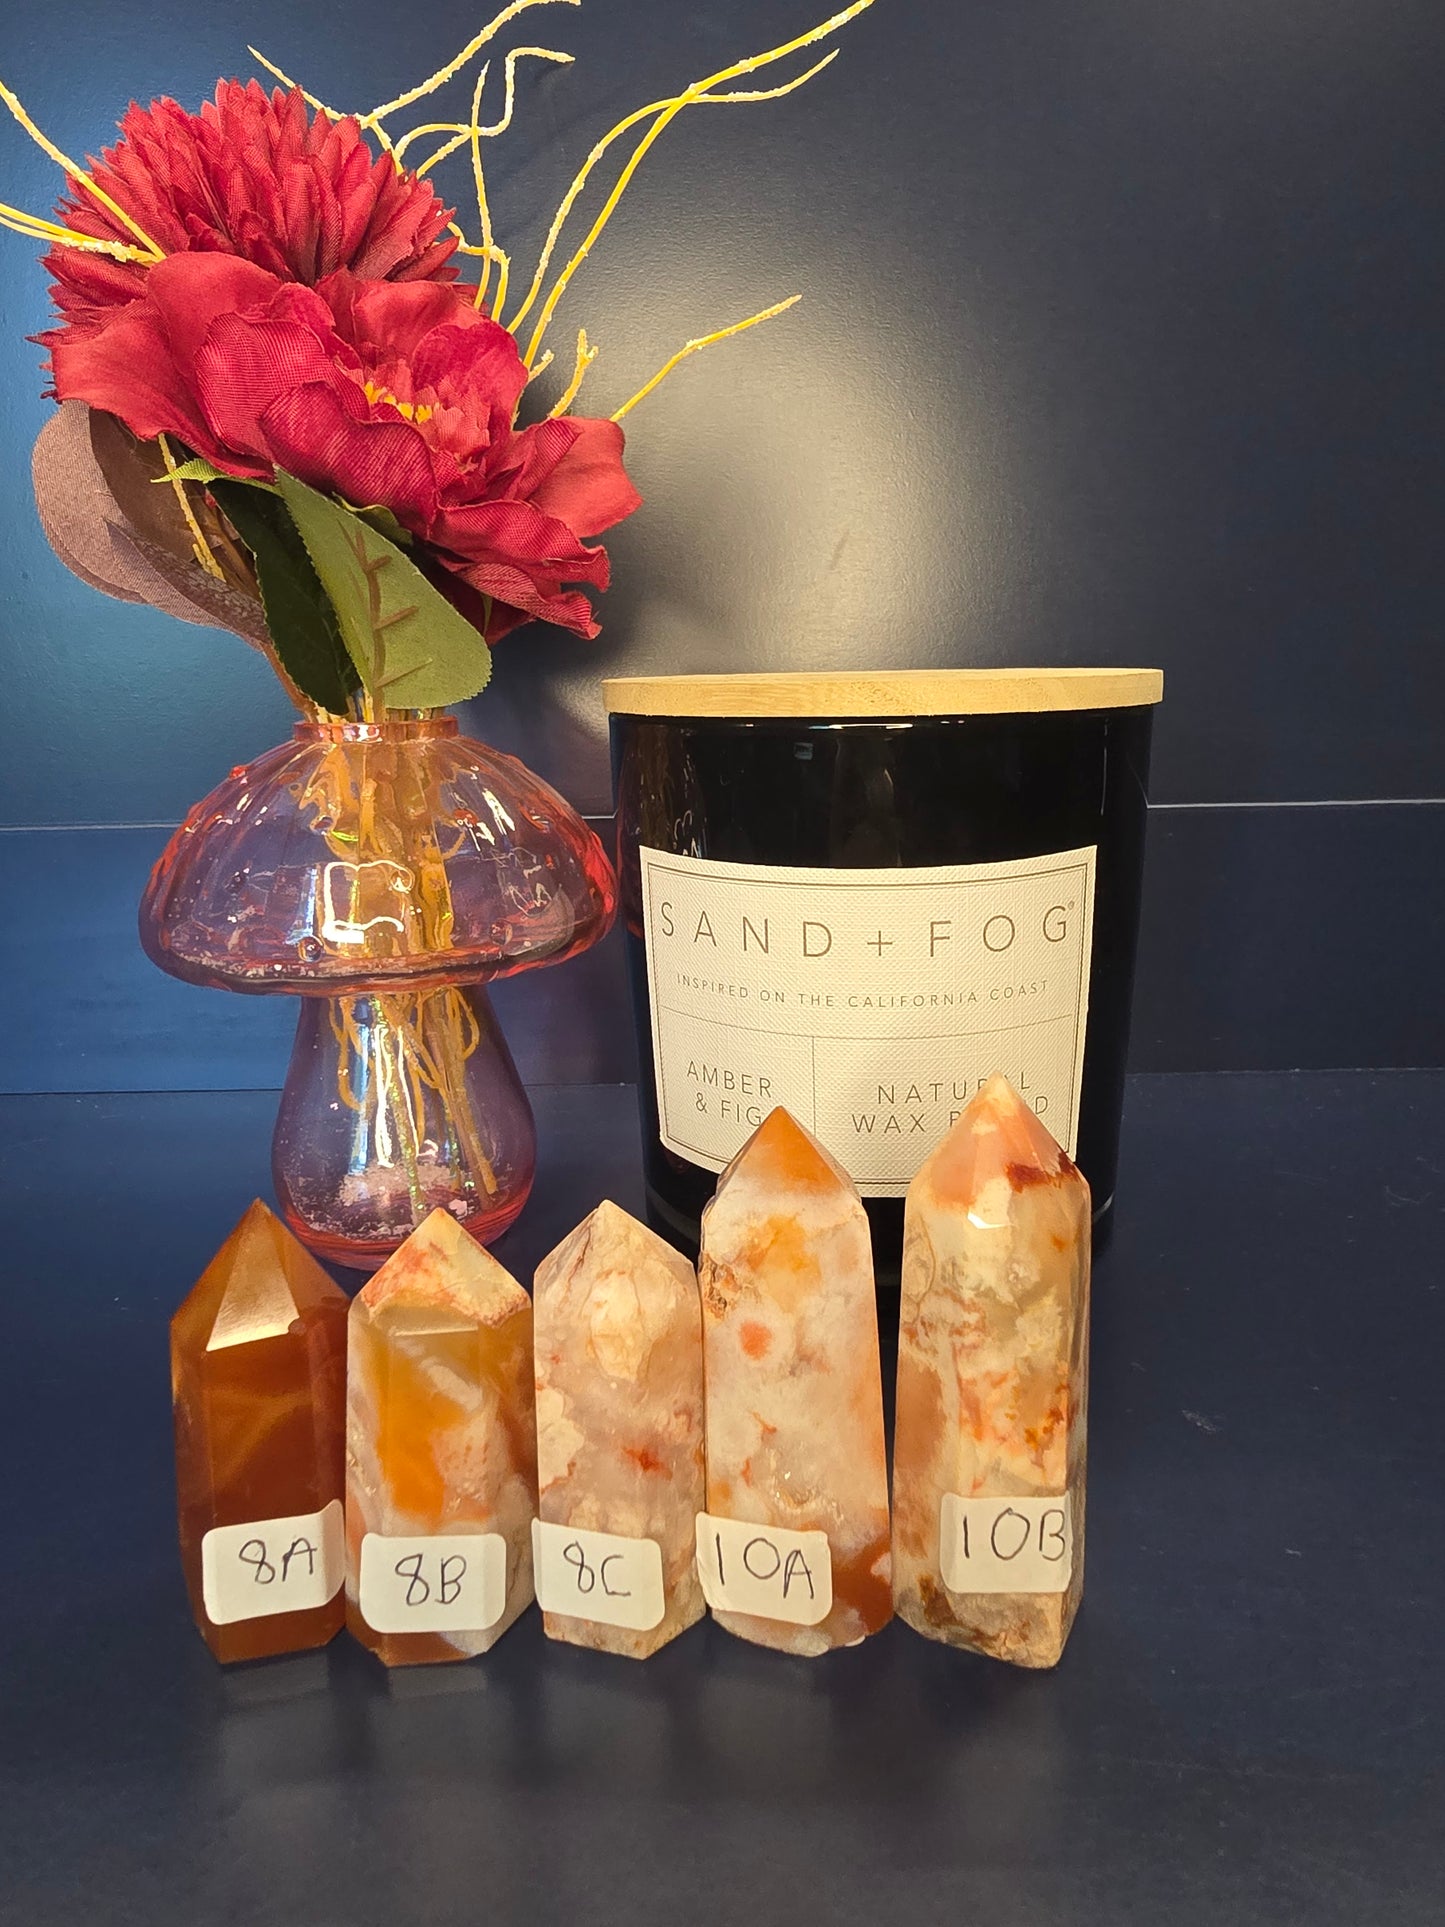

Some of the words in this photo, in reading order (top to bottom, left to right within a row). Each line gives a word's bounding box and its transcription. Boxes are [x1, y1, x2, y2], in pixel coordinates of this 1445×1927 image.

[660, 901, 833, 958] SAND
[866, 929, 894, 957] +
[677, 973, 749, 999] INSPIRED
[759, 989, 786, 1004] ON
[798, 993, 835, 1008] THE
[848, 991, 978, 1008] CALIFORNIA
[989, 979, 1050, 1002] COAST
[686, 1060, 772, 1099] AMBER
[695, 1091, 708, 1114] &
[720, 1099, 762, 1128] FIG
[851, 1113, 926, 1134] WAX
[961, 1506, 1067, 1562] 10B
[238, 1536, 319, 1585] 8A
[394, 1552, 468, 1607] 8B
[563, 1540, 632, 1596] 8C
[715, 1532, 815, 1600] 10A
